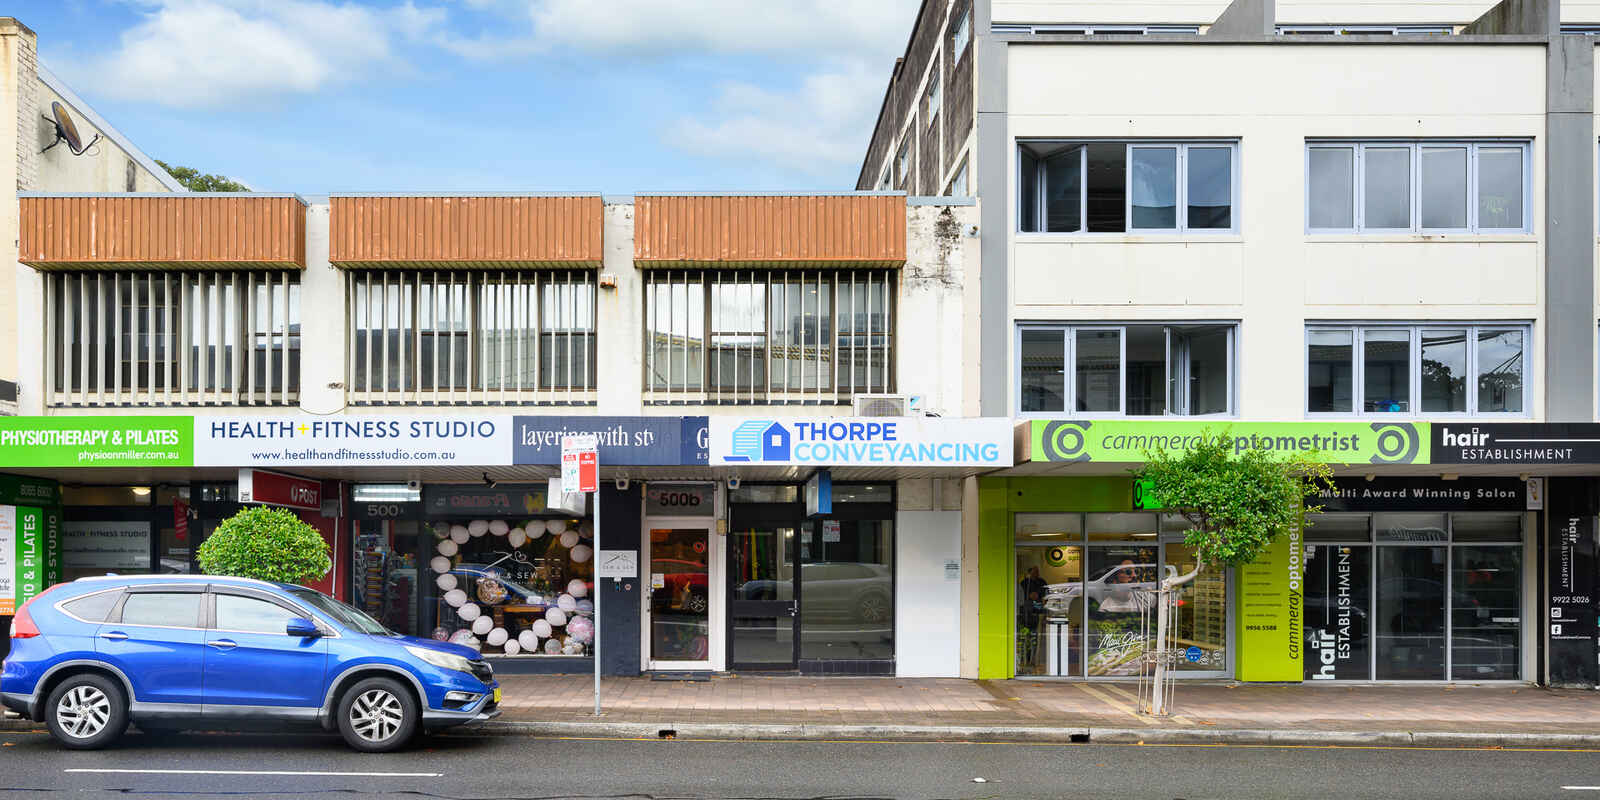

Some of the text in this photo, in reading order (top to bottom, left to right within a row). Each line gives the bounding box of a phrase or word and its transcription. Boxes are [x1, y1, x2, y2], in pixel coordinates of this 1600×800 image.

[1, 429, 179, 446] PHYSIOTHERAPY & PILATES
[211, 421, 294, 438] HEALTH
[312, 421, 400, 438] FITNESS
[410, 420, 495, 438] STUDIO
[521, 424, 590, 452] layeri
[592, 425, 629, 447] with
[794, 422, 897, 441] THORPE
[1442, 428, 1489, 447] hair
[78, 450, 179, 461] physioonmiller.com.au
[251, 447, 456, 461] www.healthandfitnessstudio.com.au
[794, 442, 999, 462] CONVEYANCING
[1461, 448, 1573, 460] ESTABLISHMENT
[299, 488, 318, 505] POST
[660, 492, 700, 507] 500b
[1319, 488, 1516, 500] Multi Award Winning Salon
[24, 513, 36, 567] PILATES
[1569, 518, 1581, 544] hair
[48, 514, 57, 567] STUDIO
[1561, 528, 1569, 588] ESTABLISHMENT
[24, 570, 35, 580] &
[516, 571, 539, 580] SEW
[1338, 544, 1351, 659] ESTABLISHMENT
[1552, 595, 1590, 604] 9922 5026
[1288, 589, 1302, 660] cammeray
[1312, 628, 1336, 680] hair
